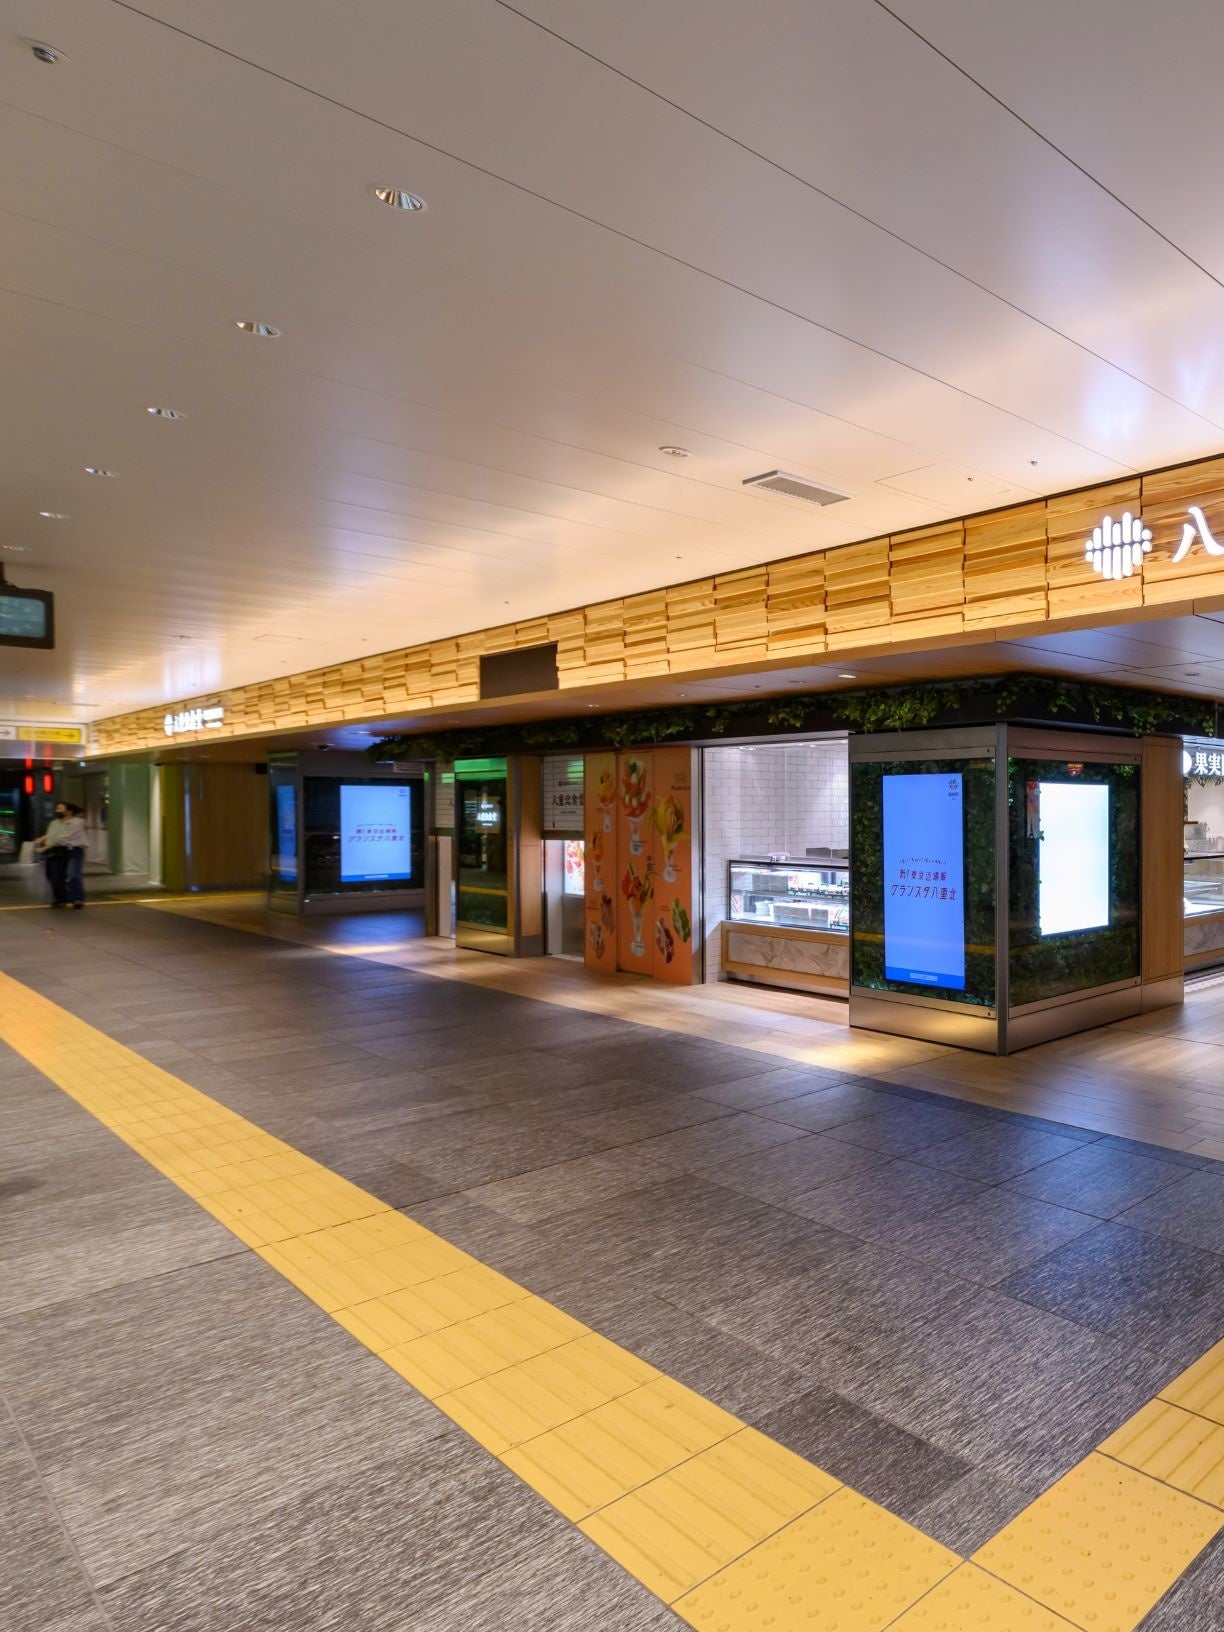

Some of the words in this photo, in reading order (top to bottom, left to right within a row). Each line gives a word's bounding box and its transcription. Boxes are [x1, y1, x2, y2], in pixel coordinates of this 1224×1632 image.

[891, 885, 957, 900] グランスタ八重北
